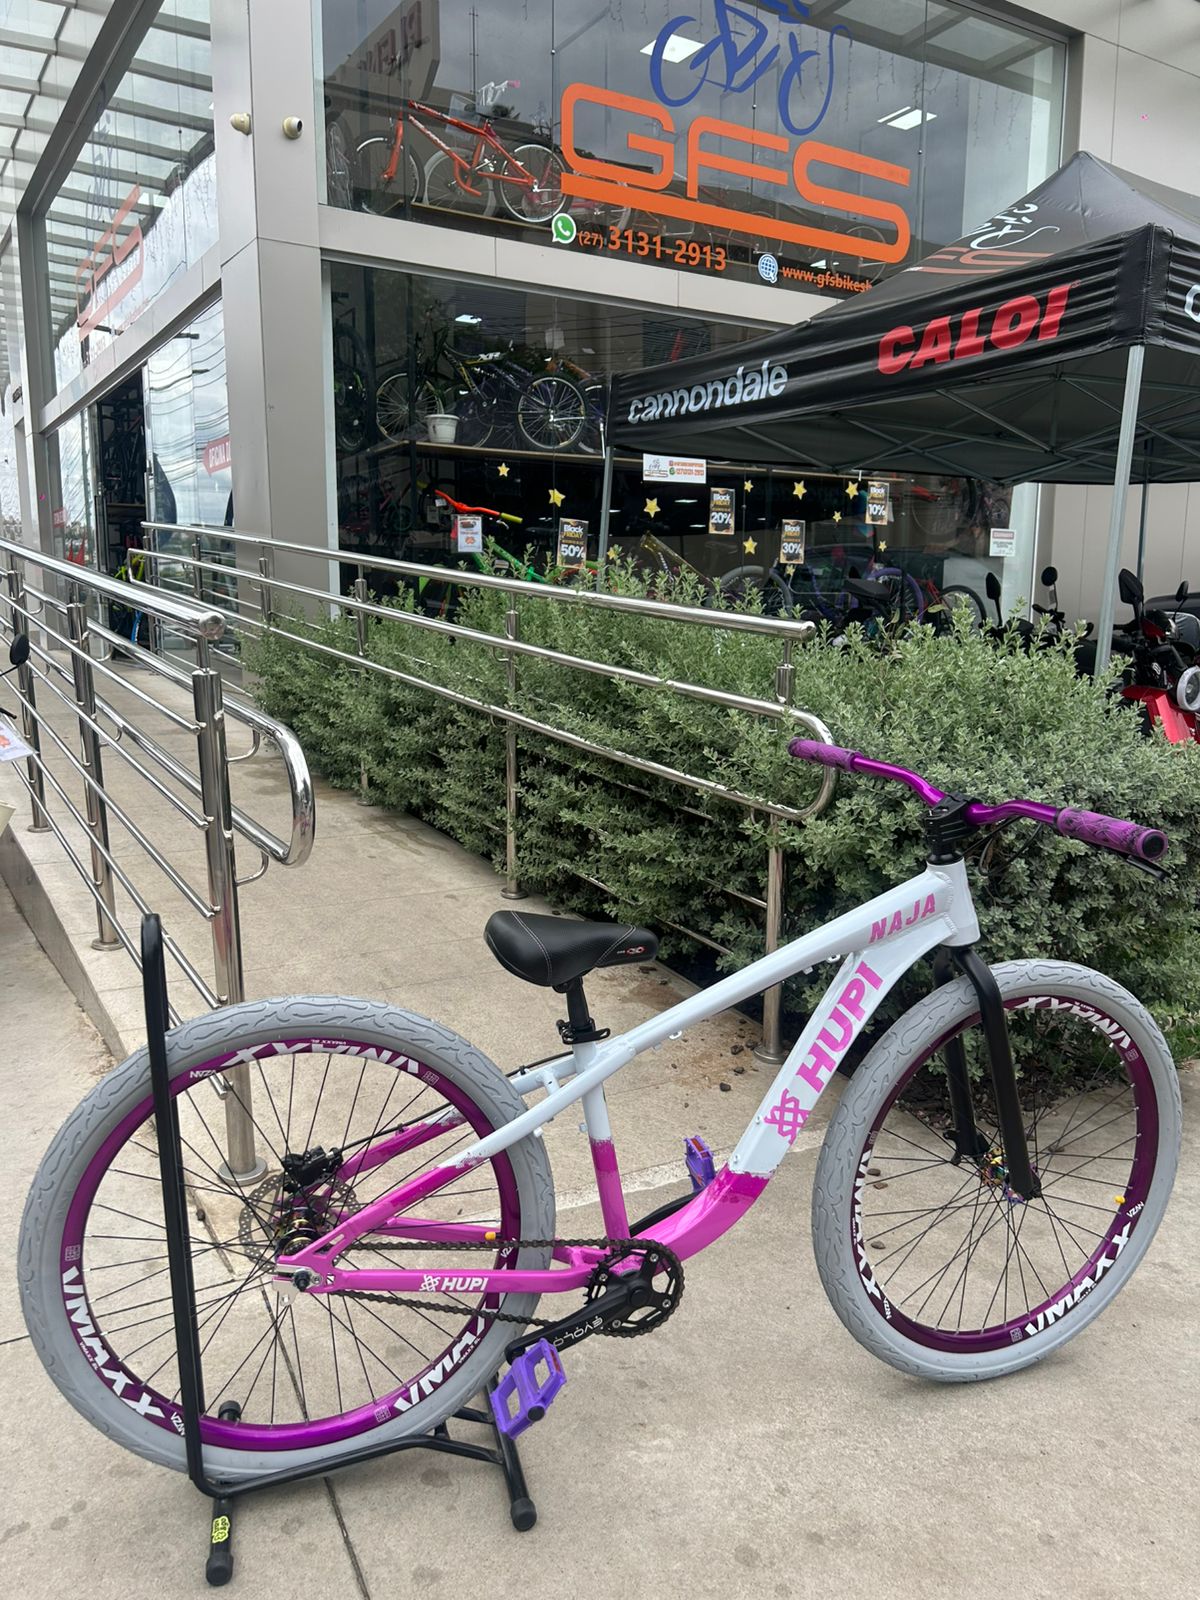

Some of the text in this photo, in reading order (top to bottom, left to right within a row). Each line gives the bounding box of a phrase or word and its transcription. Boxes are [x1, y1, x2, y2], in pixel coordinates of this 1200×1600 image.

[561, 82, 911, 263] GFS
[578, 226, 727, 272] (27) 3131-2913
[876, 284, 1070, 375] CALOI
[627, 360, 789, 424] cannondale
[711, 512, 732, 525] 20%
[869, 503, 886, 516] 10%
[561, 544, 585, 558] 50%
[783, 542, 803, 555] 30%
[868, 894, 936, 943] NAJA
[796, 961, 883, 1093] HUPI
[1014, 996, 1131, 1049] VMAXX
[220, 1042, 419, 1074] VMAXX
[855, 1150, 882, 1300] VMAXX
[1126, 1201, 1144, 1218] VZAN
[441, 1277, 488, 1291] HUPI
[1024, 1221, 1131, 1337] VMAXX
[62, 1266, 166, 1418] VMAXX
[553, 1316, 604, 1348] EVOLO
